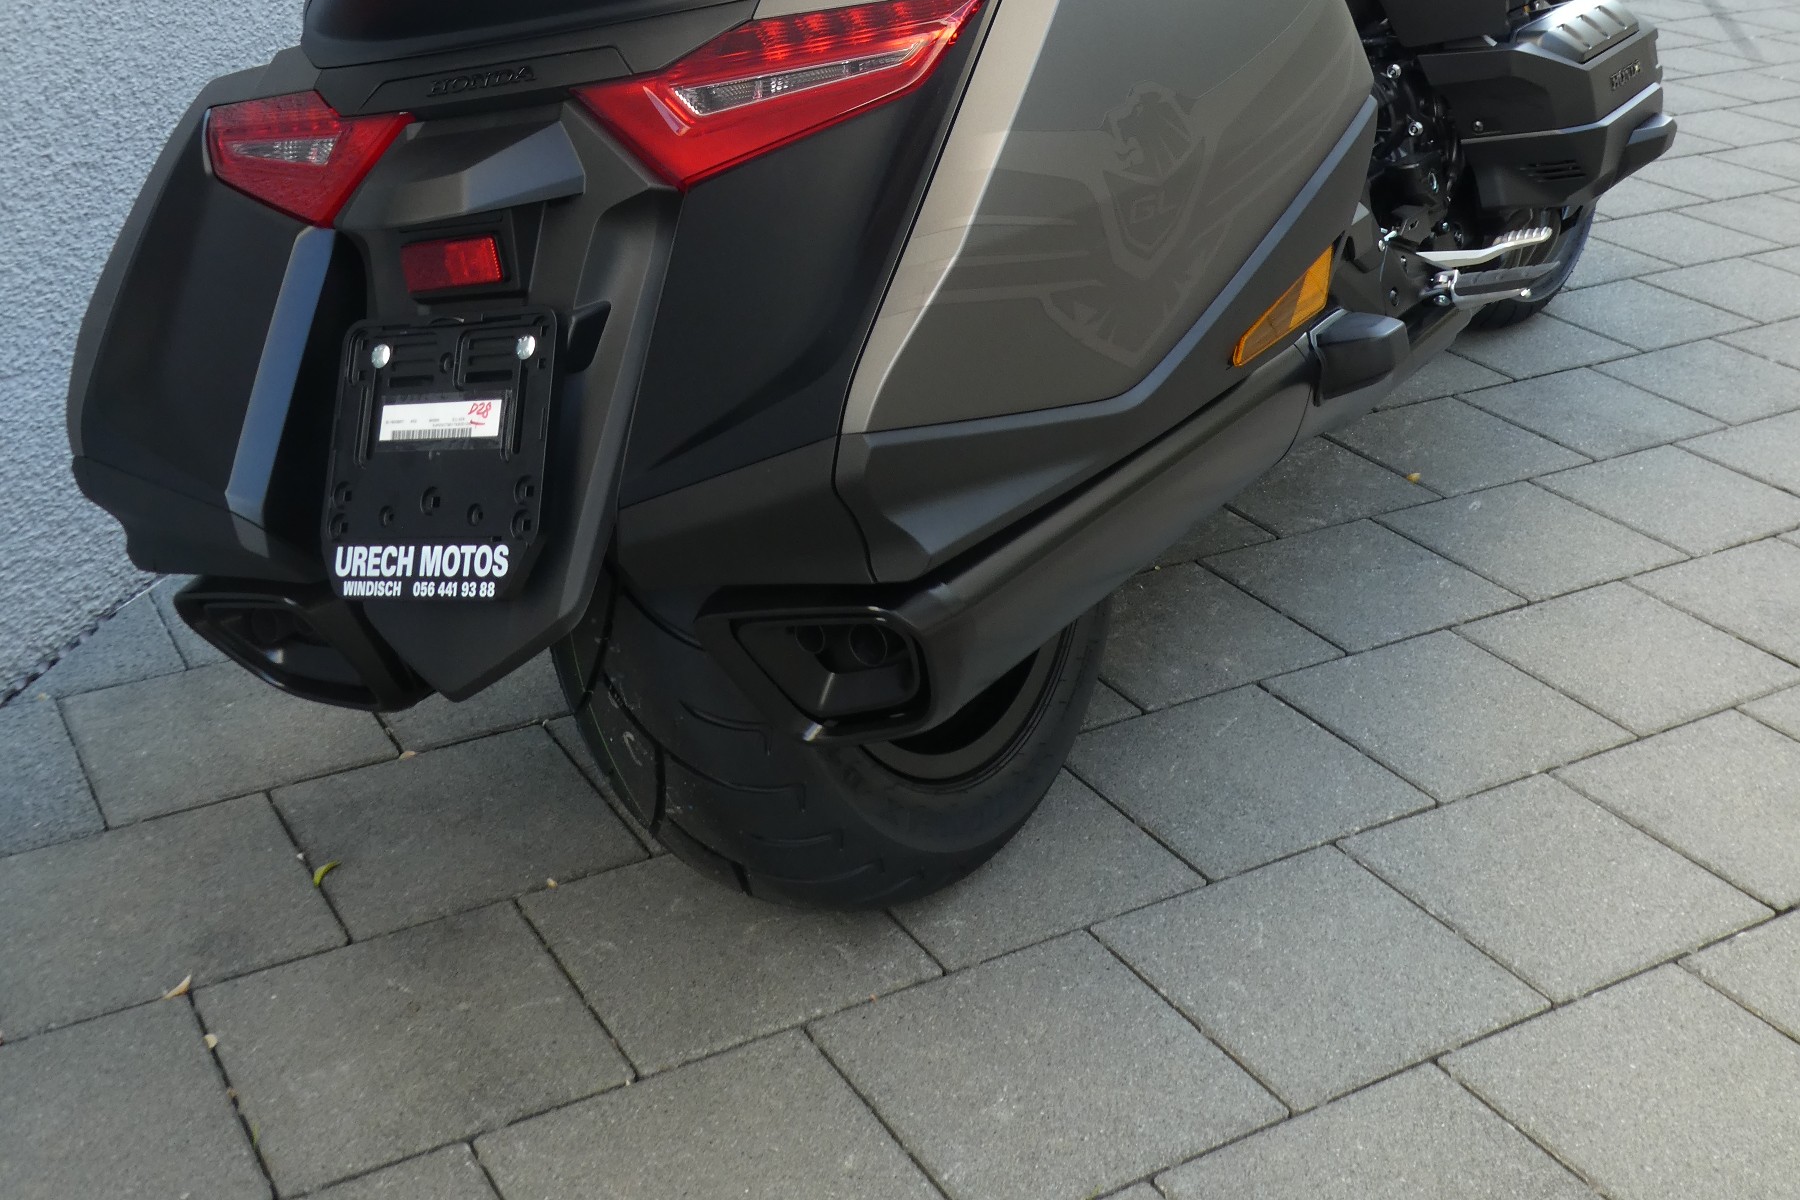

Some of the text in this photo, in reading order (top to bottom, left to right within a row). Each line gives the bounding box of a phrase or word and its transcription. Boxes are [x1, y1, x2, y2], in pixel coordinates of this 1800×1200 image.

[426, 65, 537, 97] HONDA
[335, 545, 509, 577] URECH MOTOS
[343, 581, 496, 597] WINDISCH 056 441 93 88
